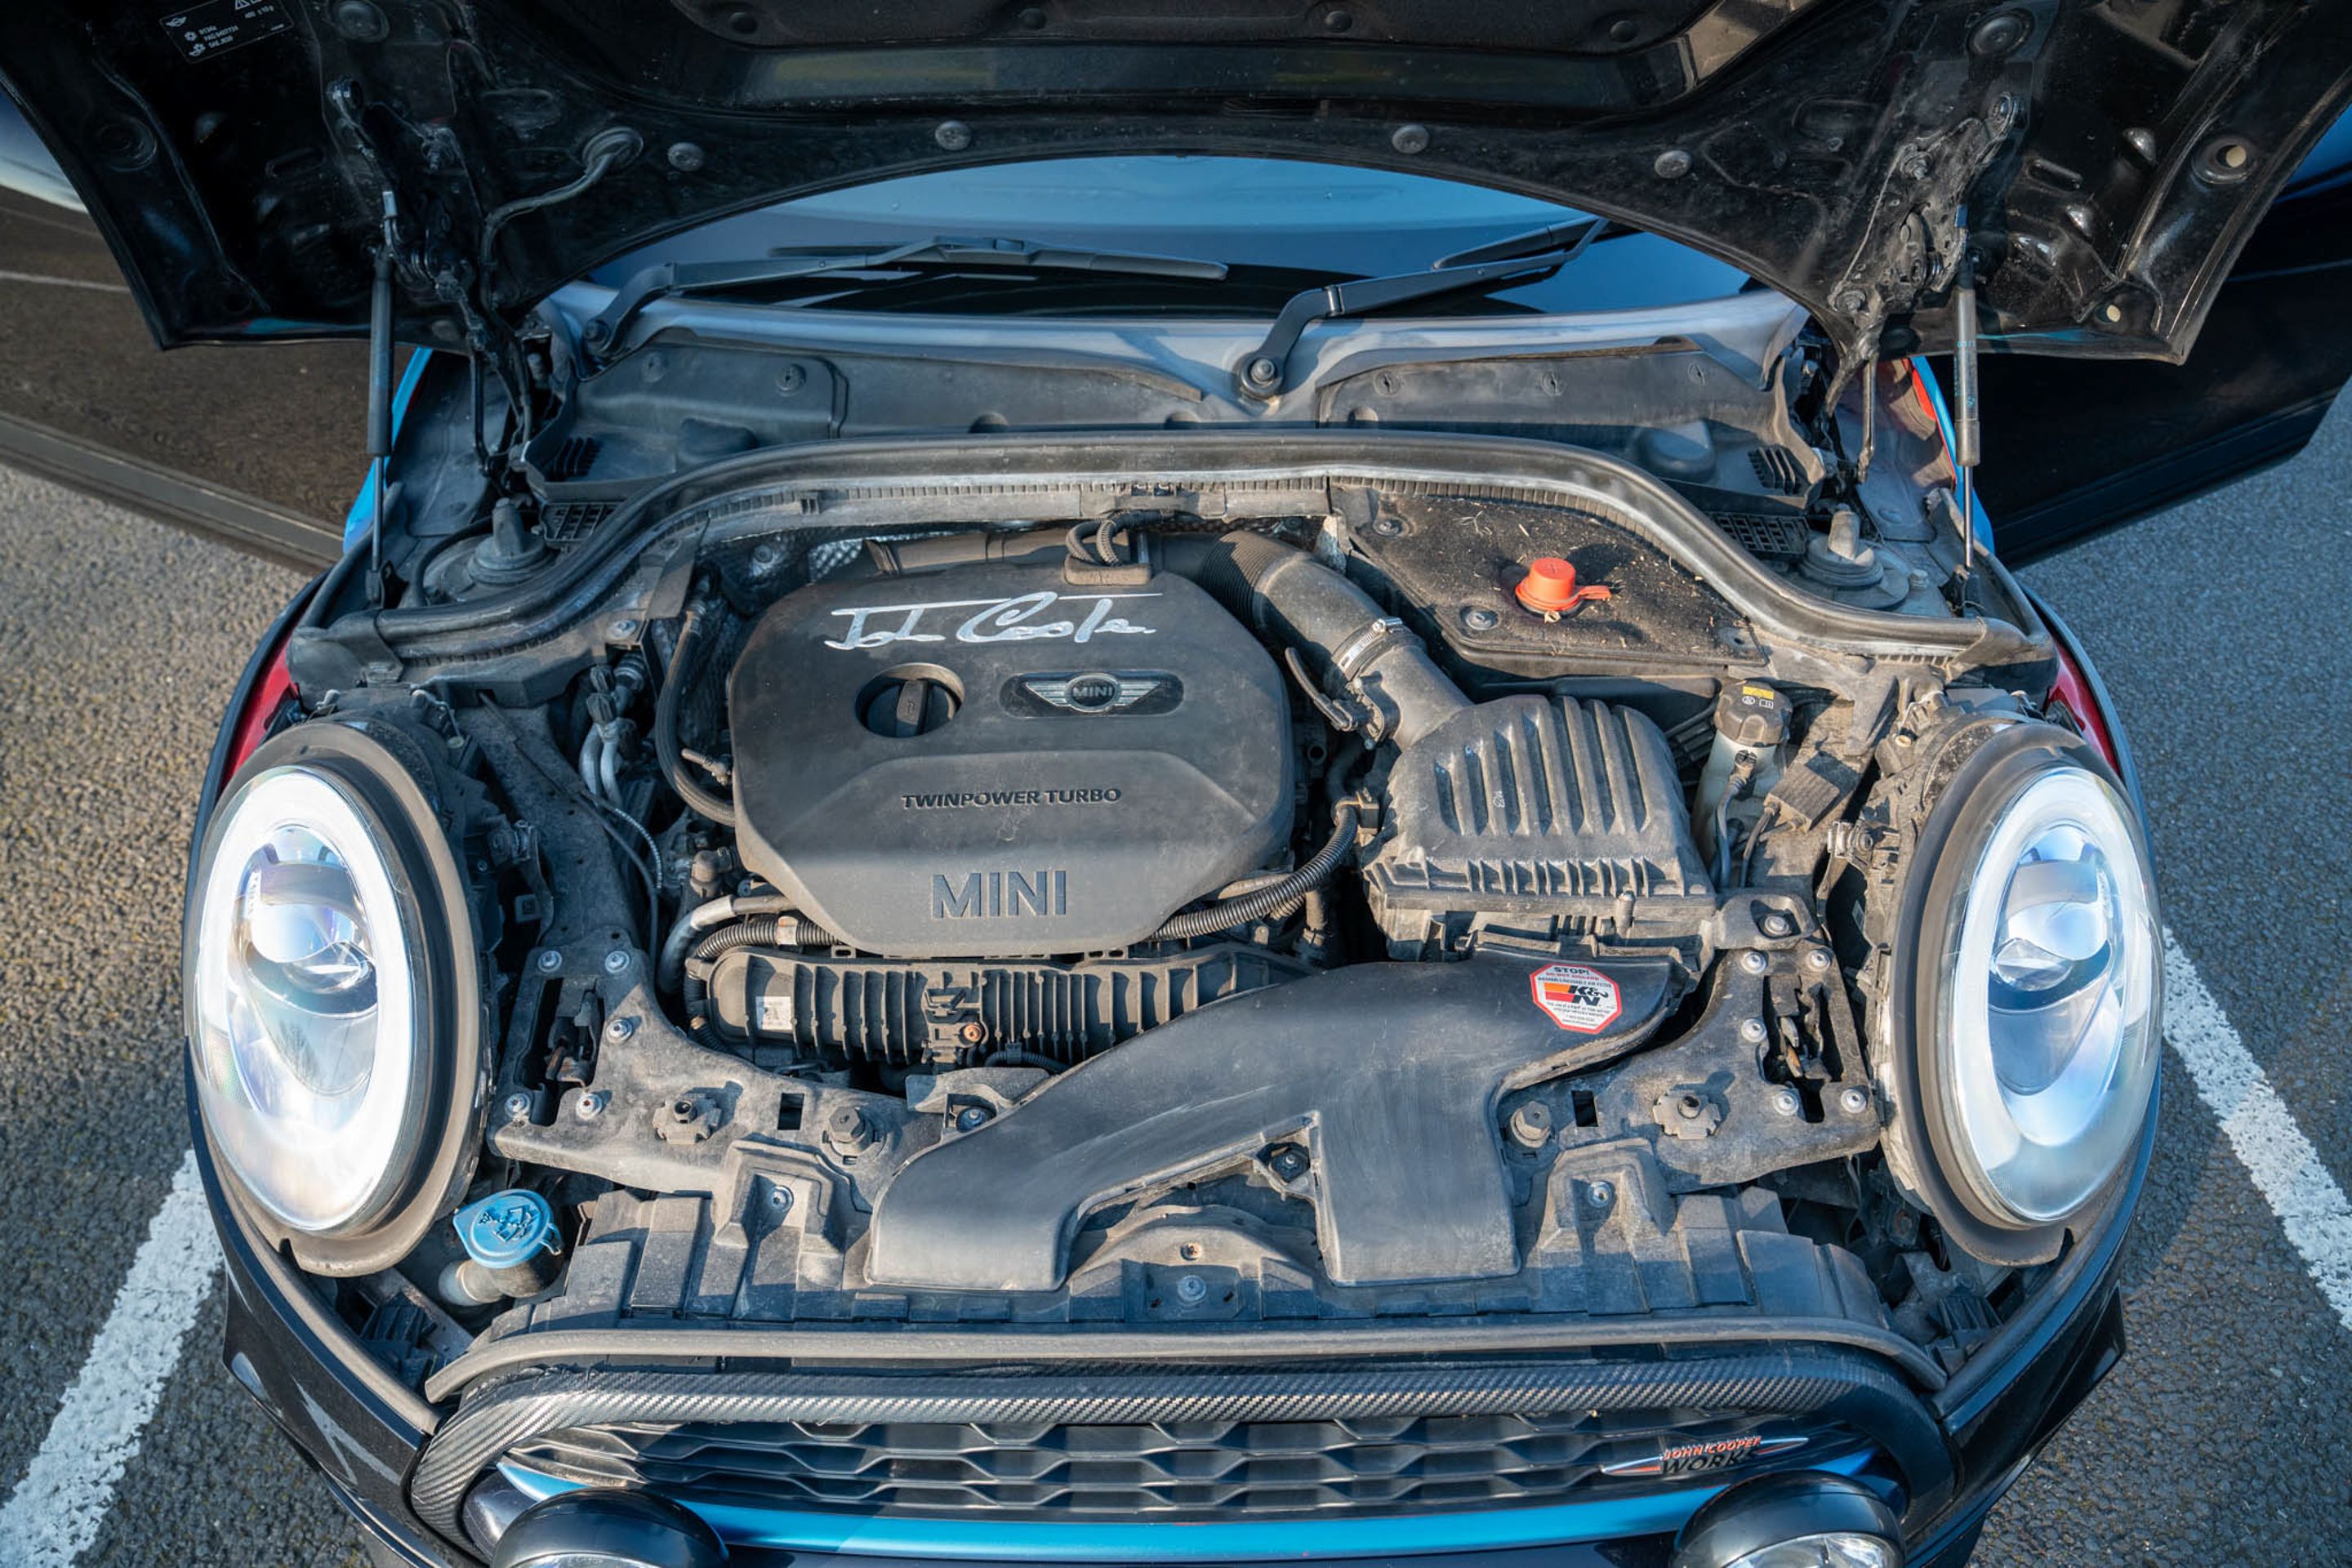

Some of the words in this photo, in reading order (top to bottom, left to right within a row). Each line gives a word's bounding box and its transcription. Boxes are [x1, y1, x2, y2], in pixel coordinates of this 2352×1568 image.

[1071, 684, 1114, 700] MINI
[902, 790, 1041, 809] TWINPOWER
[1045, 787, 1122, 805] TURBO
[931, 869, 1067, 920] MINI
[1553, 967, 1589, 975] STOP!
[1663, 1446, 1704, 1460] JOHN
[1708, 1436, 1762, 1454] COOPER
